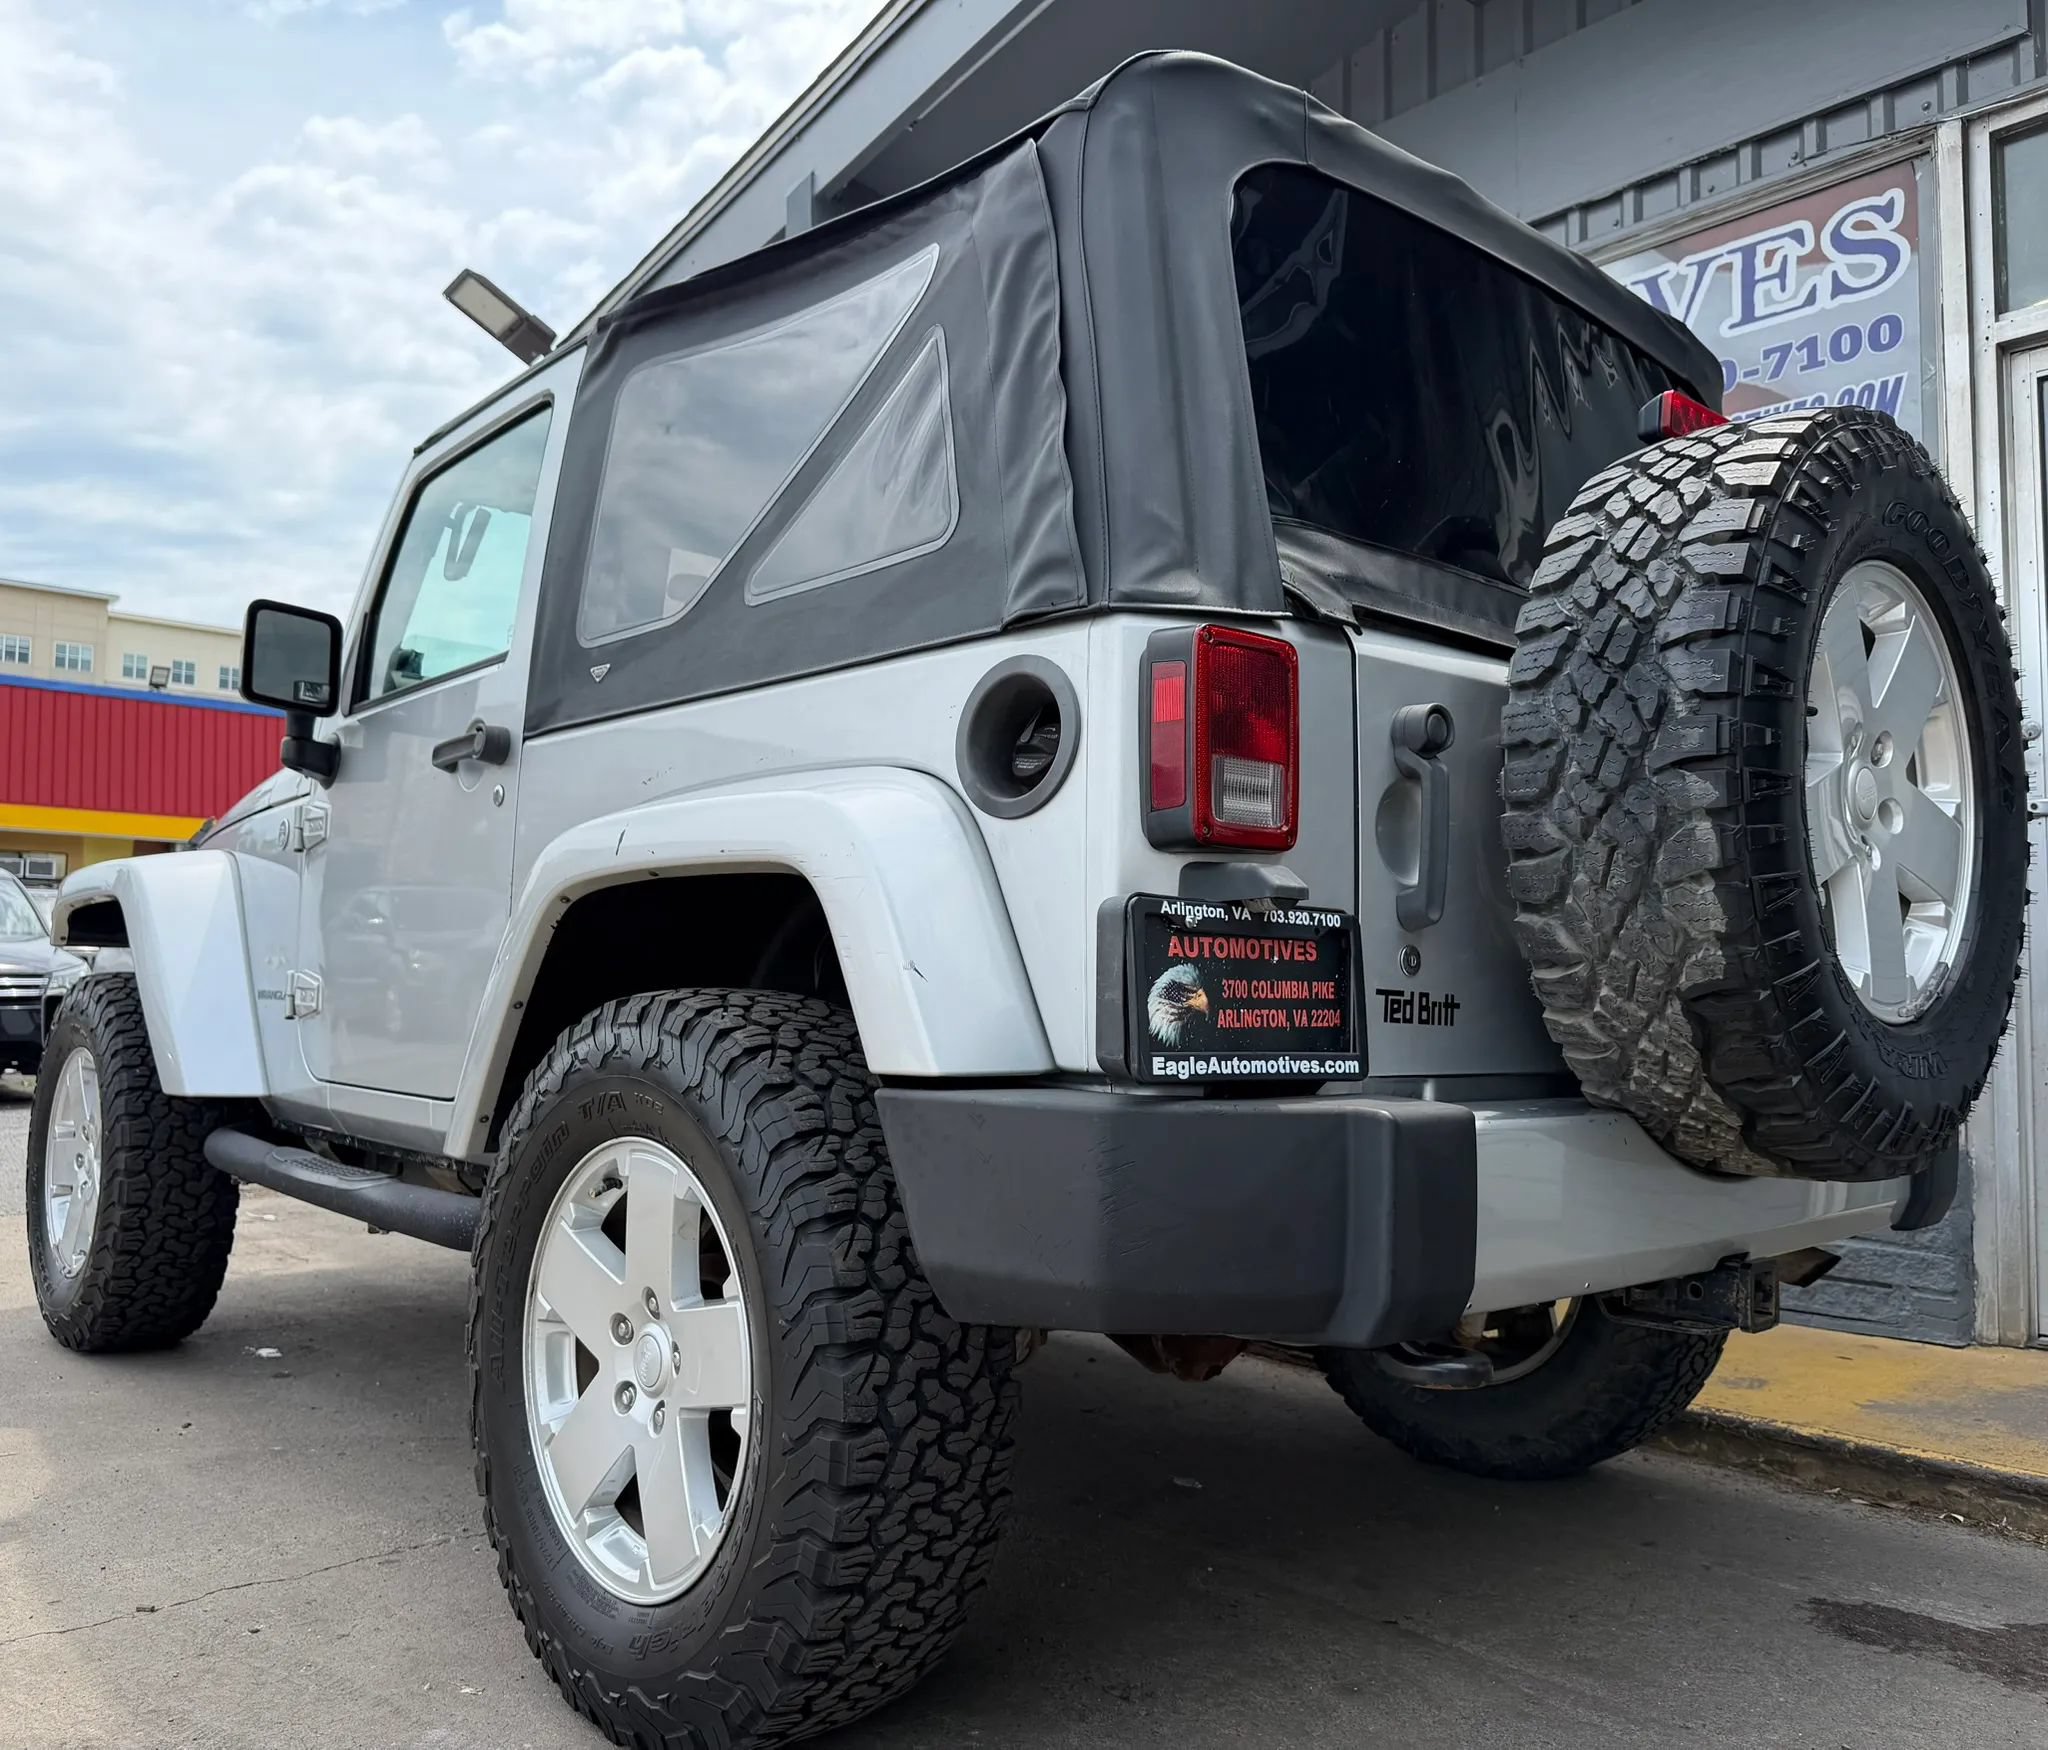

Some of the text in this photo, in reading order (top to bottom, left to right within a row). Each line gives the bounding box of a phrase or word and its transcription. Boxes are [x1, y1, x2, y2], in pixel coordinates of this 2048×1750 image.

[1161, 900, 1342, 929] Arlington, VA 703.920.7100
[1167, 935, 1319, 962] AUTOMOTIVES
[1222, 979, 1335, 999] 3700 COLUMBIA PIKE
[1217, 1008, 1341, 1031] ARLINGTON, VA 22204
[1376, 988, 1461, 1027] Ted Britt
[1152, 1056, 1360, 1080] EagleAutomotives.com
